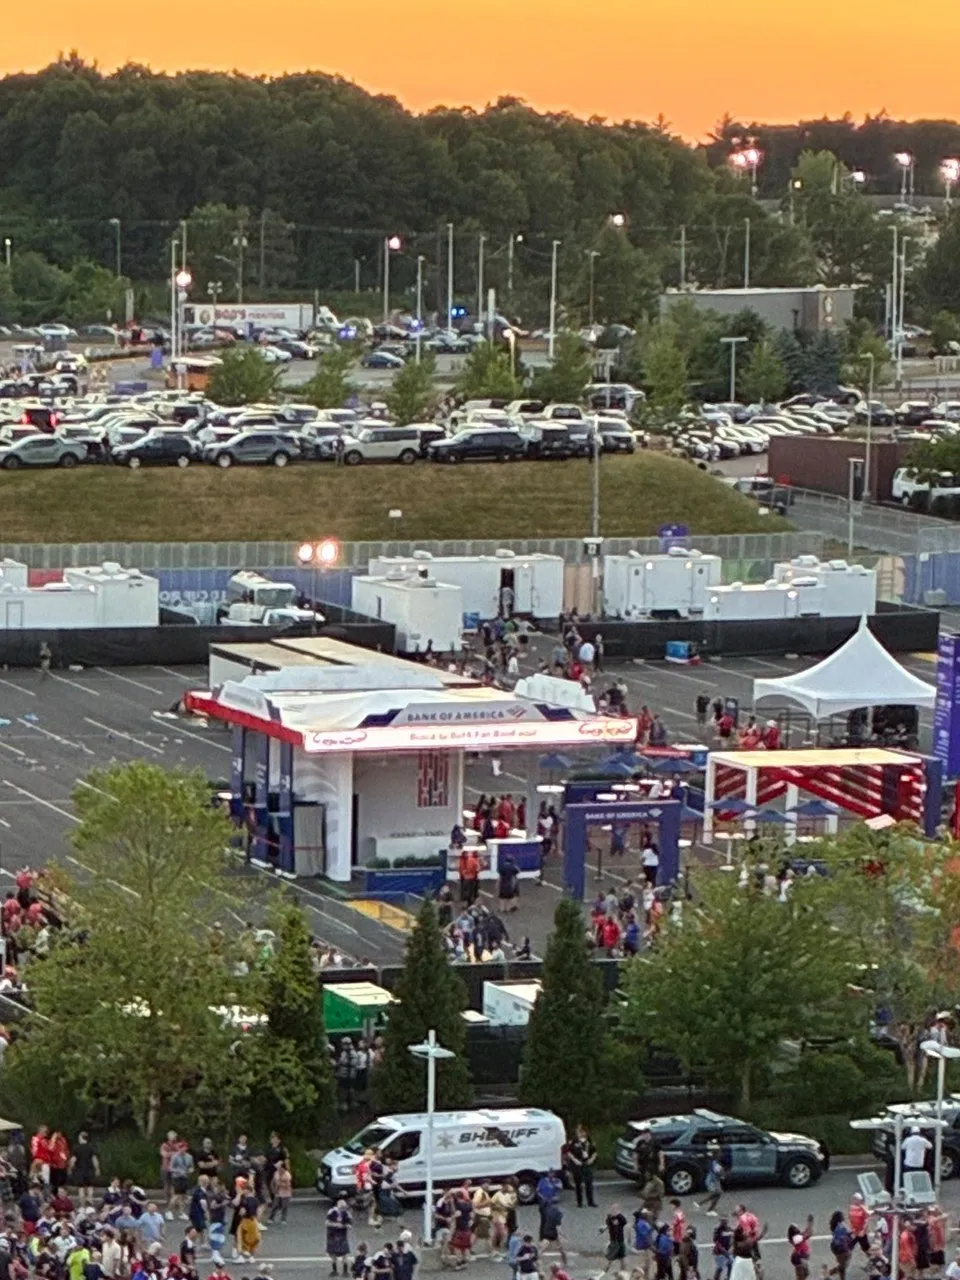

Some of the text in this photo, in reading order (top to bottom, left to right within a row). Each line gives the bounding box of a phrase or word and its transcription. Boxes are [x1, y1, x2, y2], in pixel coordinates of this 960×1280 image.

[408, 710, 504, 721] BANK OF AMERICA
[458, 1127, 540, 1144] SHERIFF
